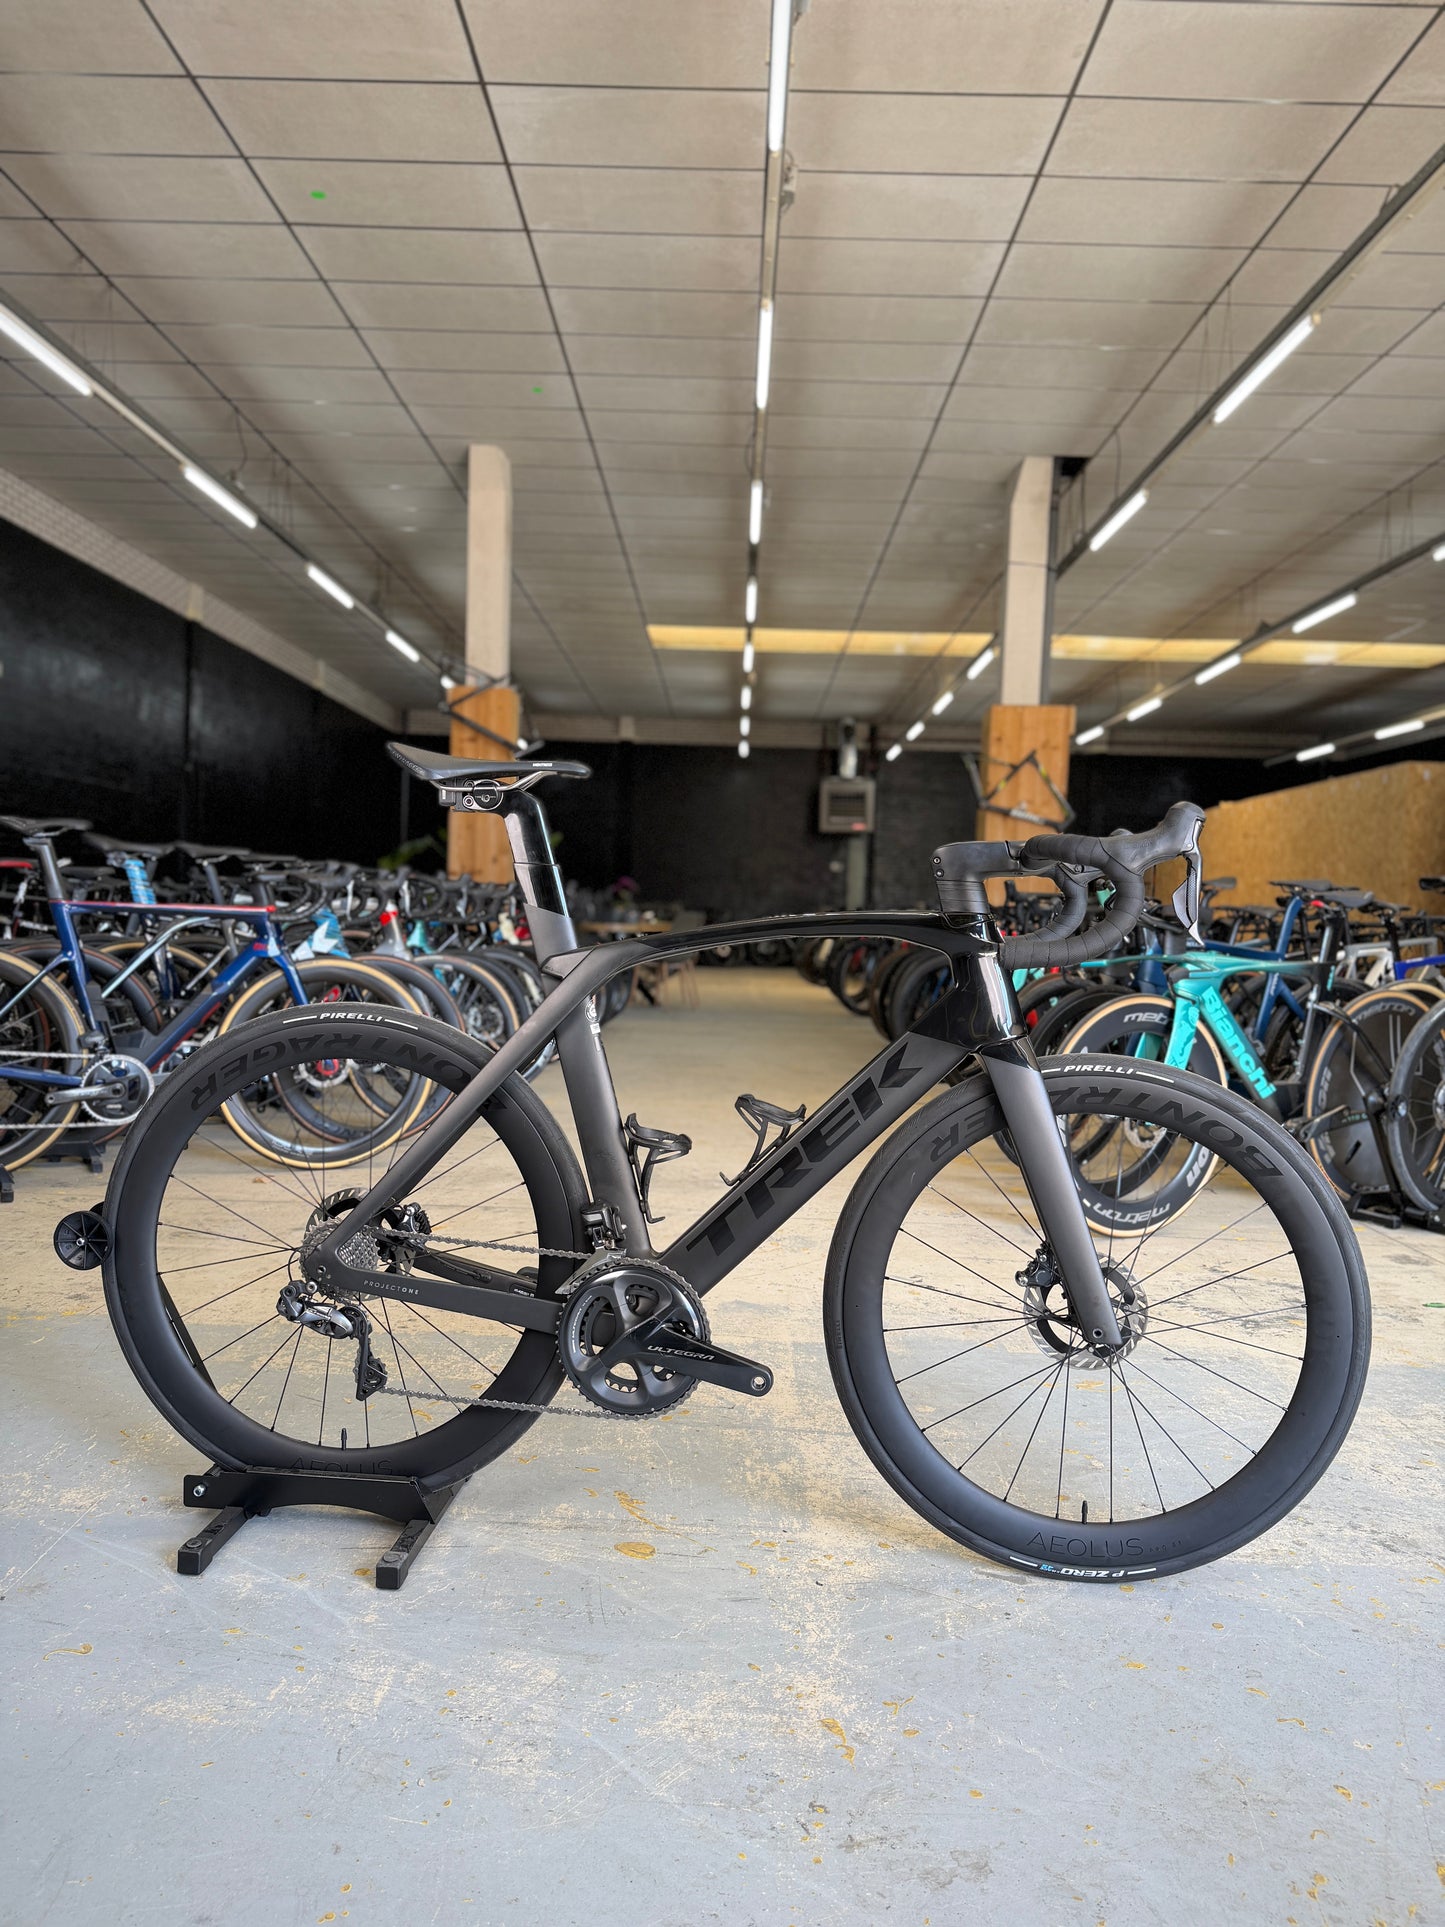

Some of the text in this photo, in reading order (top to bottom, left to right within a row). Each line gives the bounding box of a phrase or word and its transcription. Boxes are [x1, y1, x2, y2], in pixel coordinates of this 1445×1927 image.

[319, 1012, 383, 1022] PIRELLI
[1201, 986, 1277, 1100] Bianchi
[190, 1032, 474, 1112] ONTRAGER
[1063, 1064, 1134, 1075] PIRELLI
[930, 1085, 1285, 1178] BONTRAER
[685, 1041, 923, 1257] TREK
[1092, 1202, 1171, 1224] metron
[647, 1345, 716, 1361] ULTEGRA
[1026, 1531, 1144, 1558] AEOLUS
[1060, 1567, 1110, 1577] ZERO
